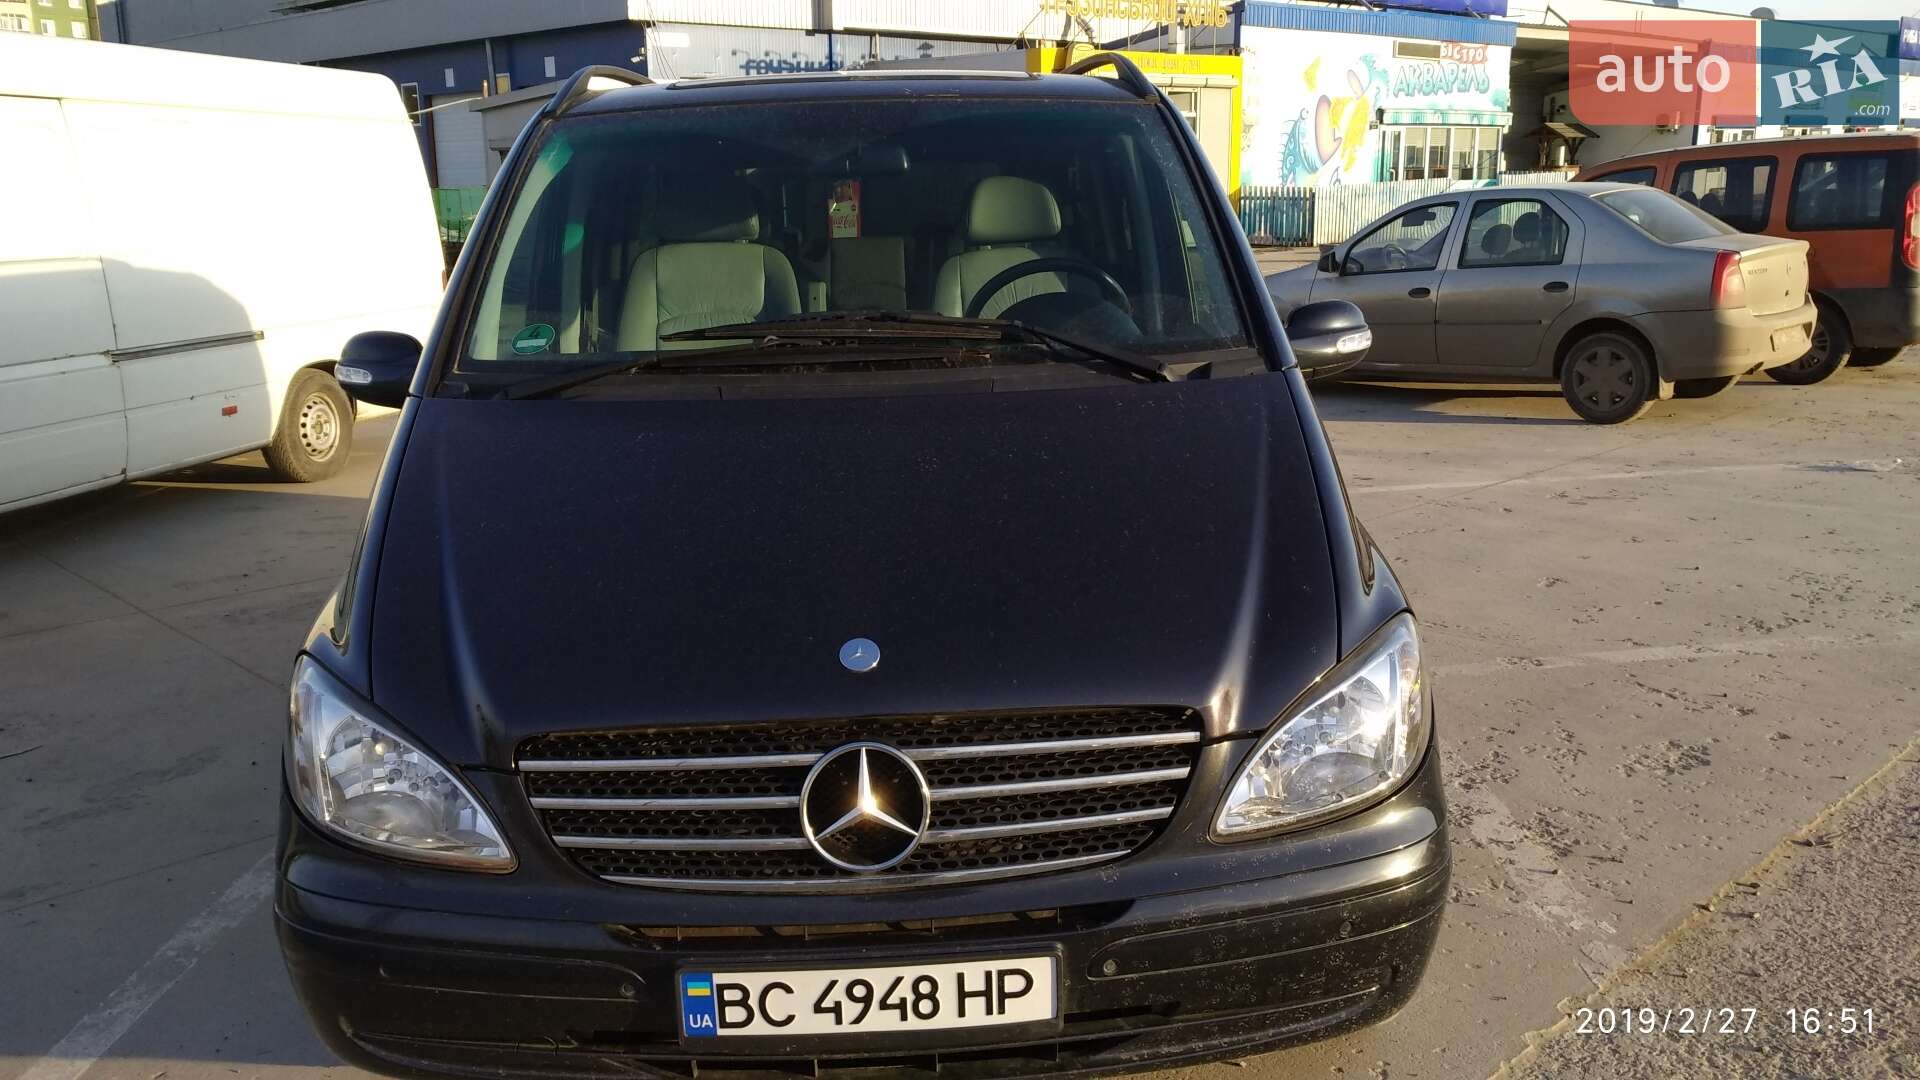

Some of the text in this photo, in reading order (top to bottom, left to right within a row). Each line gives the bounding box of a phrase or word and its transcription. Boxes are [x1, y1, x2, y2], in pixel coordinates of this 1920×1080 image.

[1393, 62, 1490, 98] АКВАРЕЛЬ
[716, 967, 1034, 1029] BC 4948 HP
[688, 1013, 714, 1029] UA
